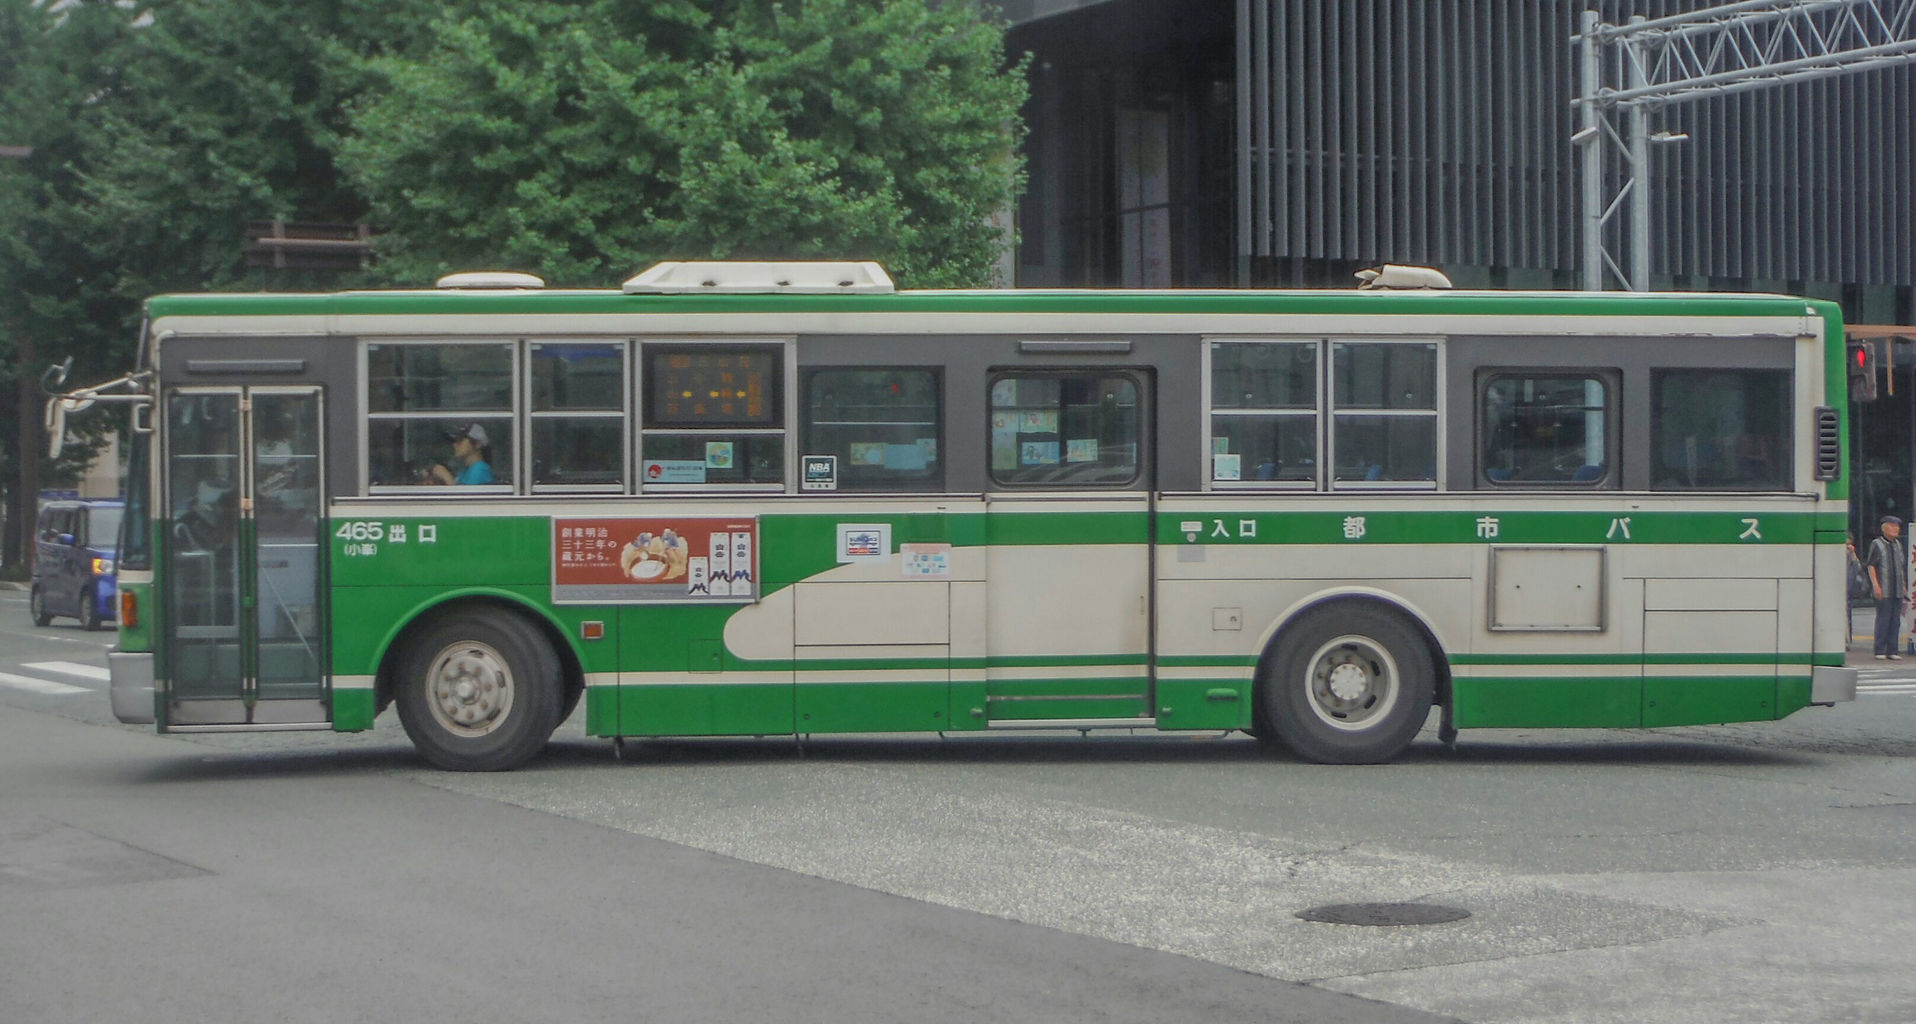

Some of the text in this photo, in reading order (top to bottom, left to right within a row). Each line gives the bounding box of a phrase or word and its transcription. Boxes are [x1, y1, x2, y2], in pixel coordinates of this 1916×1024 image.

[809, 462, 830, 473] NBA
[336, 521, 384, 541] 465
[389, 525, 436, 543] 出口
[562, 527, 608, 538] 創業明治
[1211, 519, 1256, 537] 入口
[562, 539, 617, 550] 三十三年の
